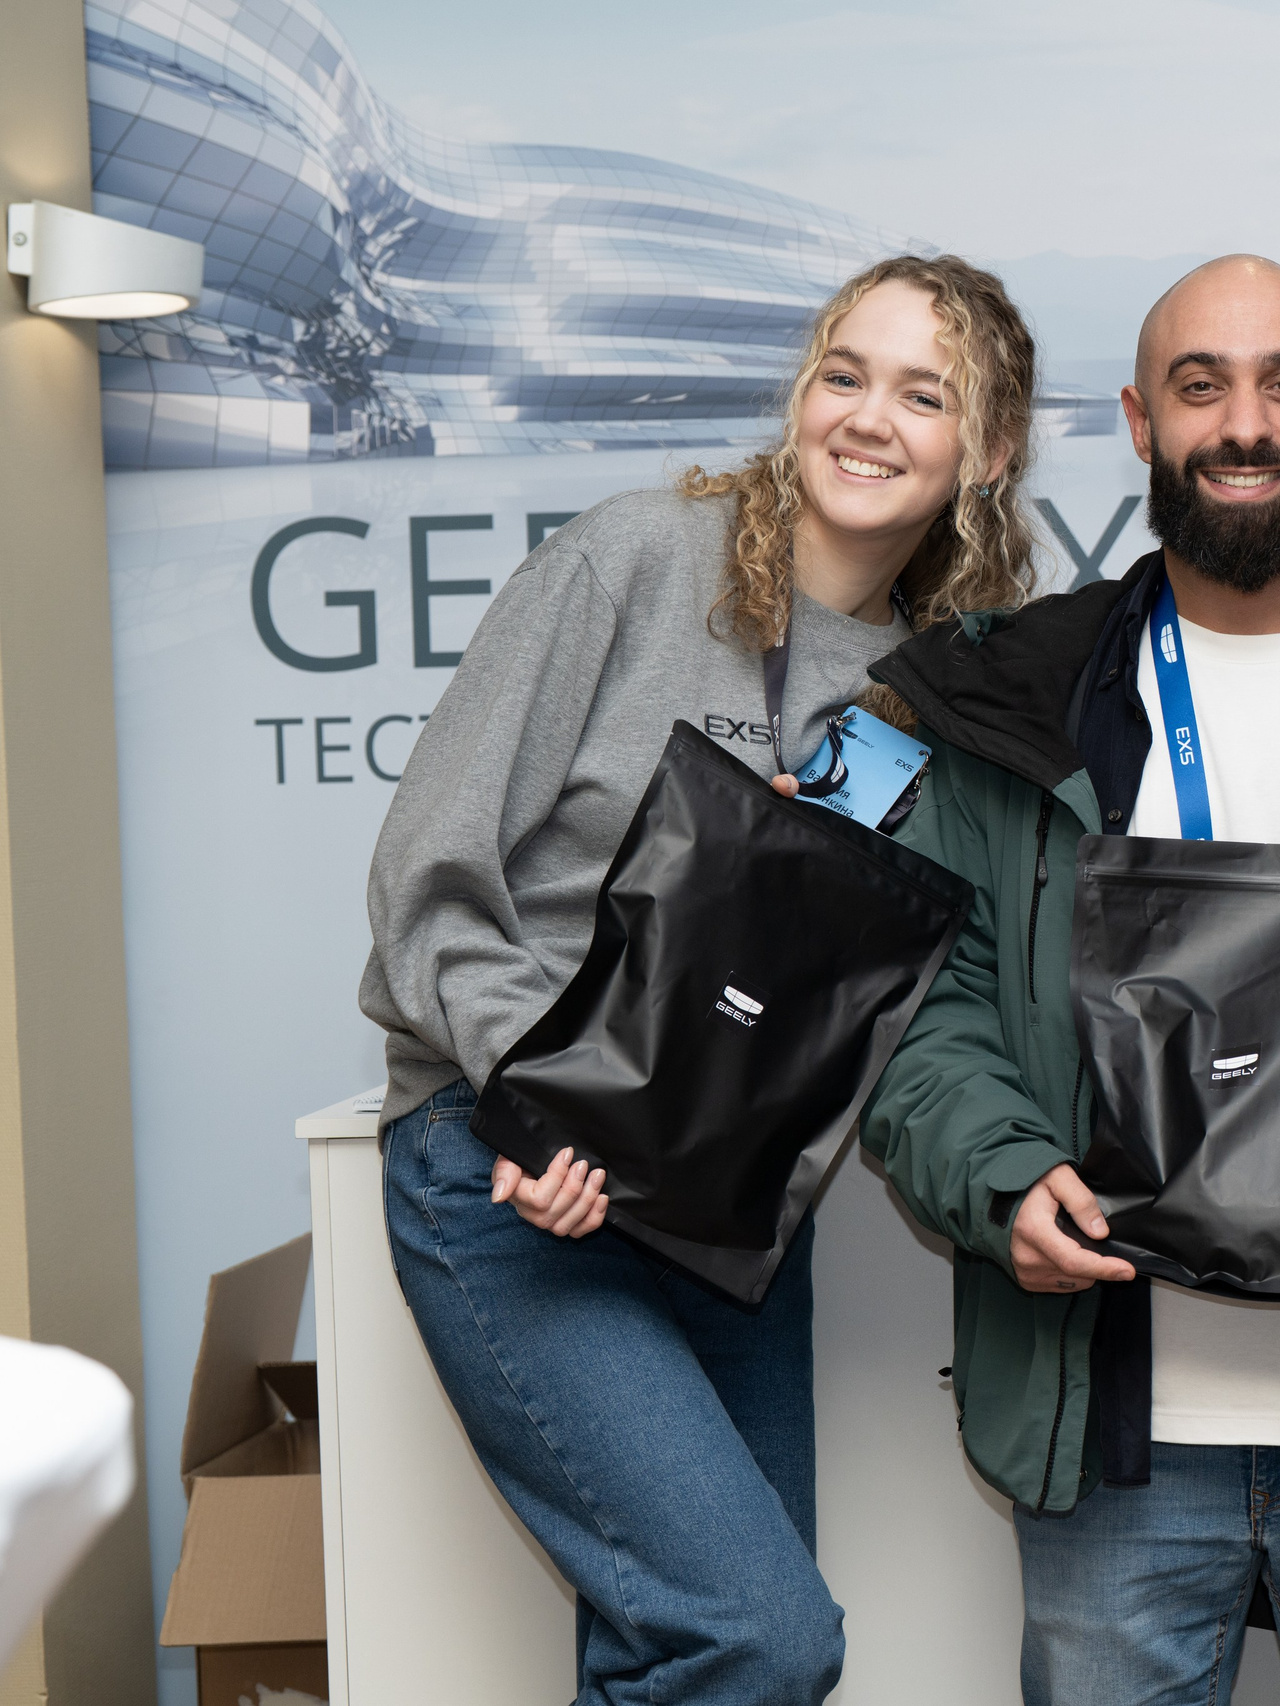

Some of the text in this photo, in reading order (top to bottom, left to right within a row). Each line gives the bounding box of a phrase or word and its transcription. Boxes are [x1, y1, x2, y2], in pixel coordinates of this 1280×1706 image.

[251, 512, 590, 674] GE
[704, 713, 772, 746] EX5
[857, 738, 875, 749] GEELY
[254, 714, 436, 785] ТЕС
[1175, 726, 1195, 766] EX5
[895, 758, 914, 773] EX5
[715, 1000, 757, 1027] GEELY
[1211, 1066, 1258, 1080] GEELY
